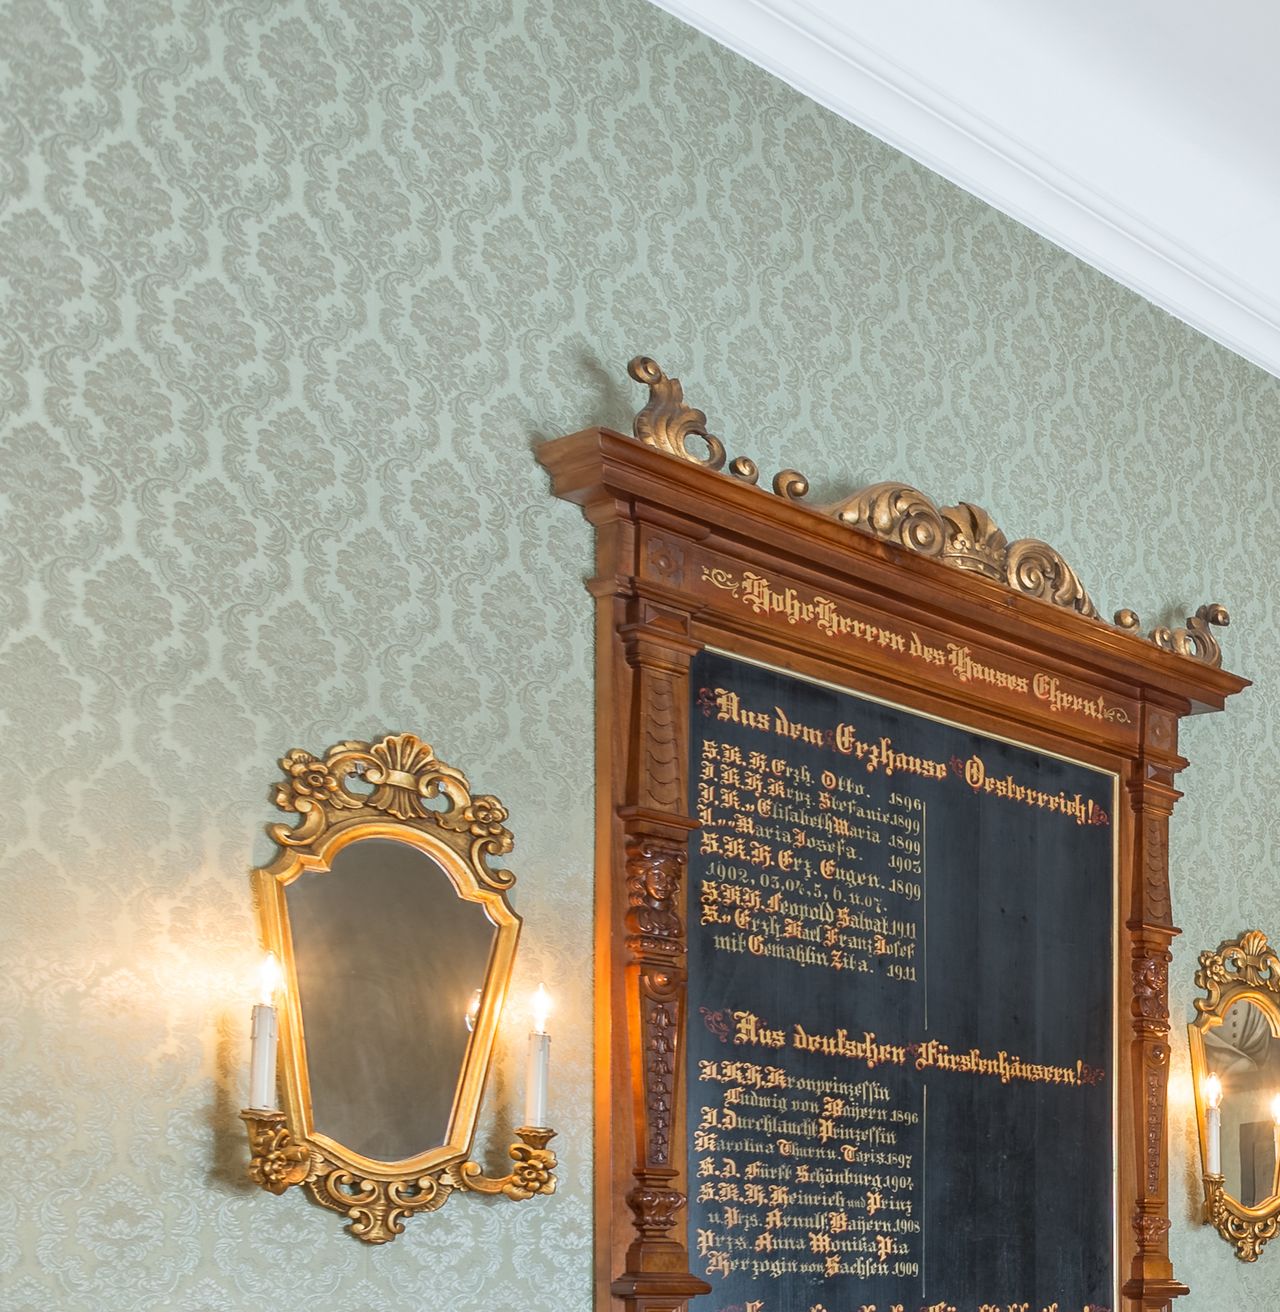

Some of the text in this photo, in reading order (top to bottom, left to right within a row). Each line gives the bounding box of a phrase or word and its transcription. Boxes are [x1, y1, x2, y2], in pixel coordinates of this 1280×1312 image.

[742, 571, 1104, 719] Hohe Herren des Hauses Ehren!
[714, 687, 1093, 826] Aus dem Erzhause Oesterreich!
[820, 770, 871, 799] Otto.
[888, 792, 922, 811] 1896
[734, 814, 792, 844] Maria
[831, 816, 881, 844] Maria
[888, 835, 921, 856] 1899
[891, 812, 921, 835] 1899
[820, 859, 886, 889] Eugen.
[888, 879, 921, 901] 1899
[767, 893, 835, 923] Leopold
[714, 932, 747, 952] mit
[748, 934, 830, 967] Gemahlin
[822, 925, 874, 957] Franz
[733, 1011, 1082, 1086] Aus deutschen Fürstenhäusern!
[724, 1087, 788, 1113] Ludwig
[791, 1099, 820, 1114] von
[889, 1110, 919, 1126] 1896
[694, 1131, 776, 1154] Karolina
[767, 1184, 845, 1209] Heinrich
[845, 1198, 867, 1210] und
[866, 1191, 913, 1216] Prinz
[893, 1219, 921, 1233] 1908
[754, 1231, 807, 1252] Anna
[877, 1235, 910, 1261] Pia
[705, 1251, 798, 1279] Herzogin
[799, 1263, 825, 1274] von
[892, 1263, 919, 1277] 1909
